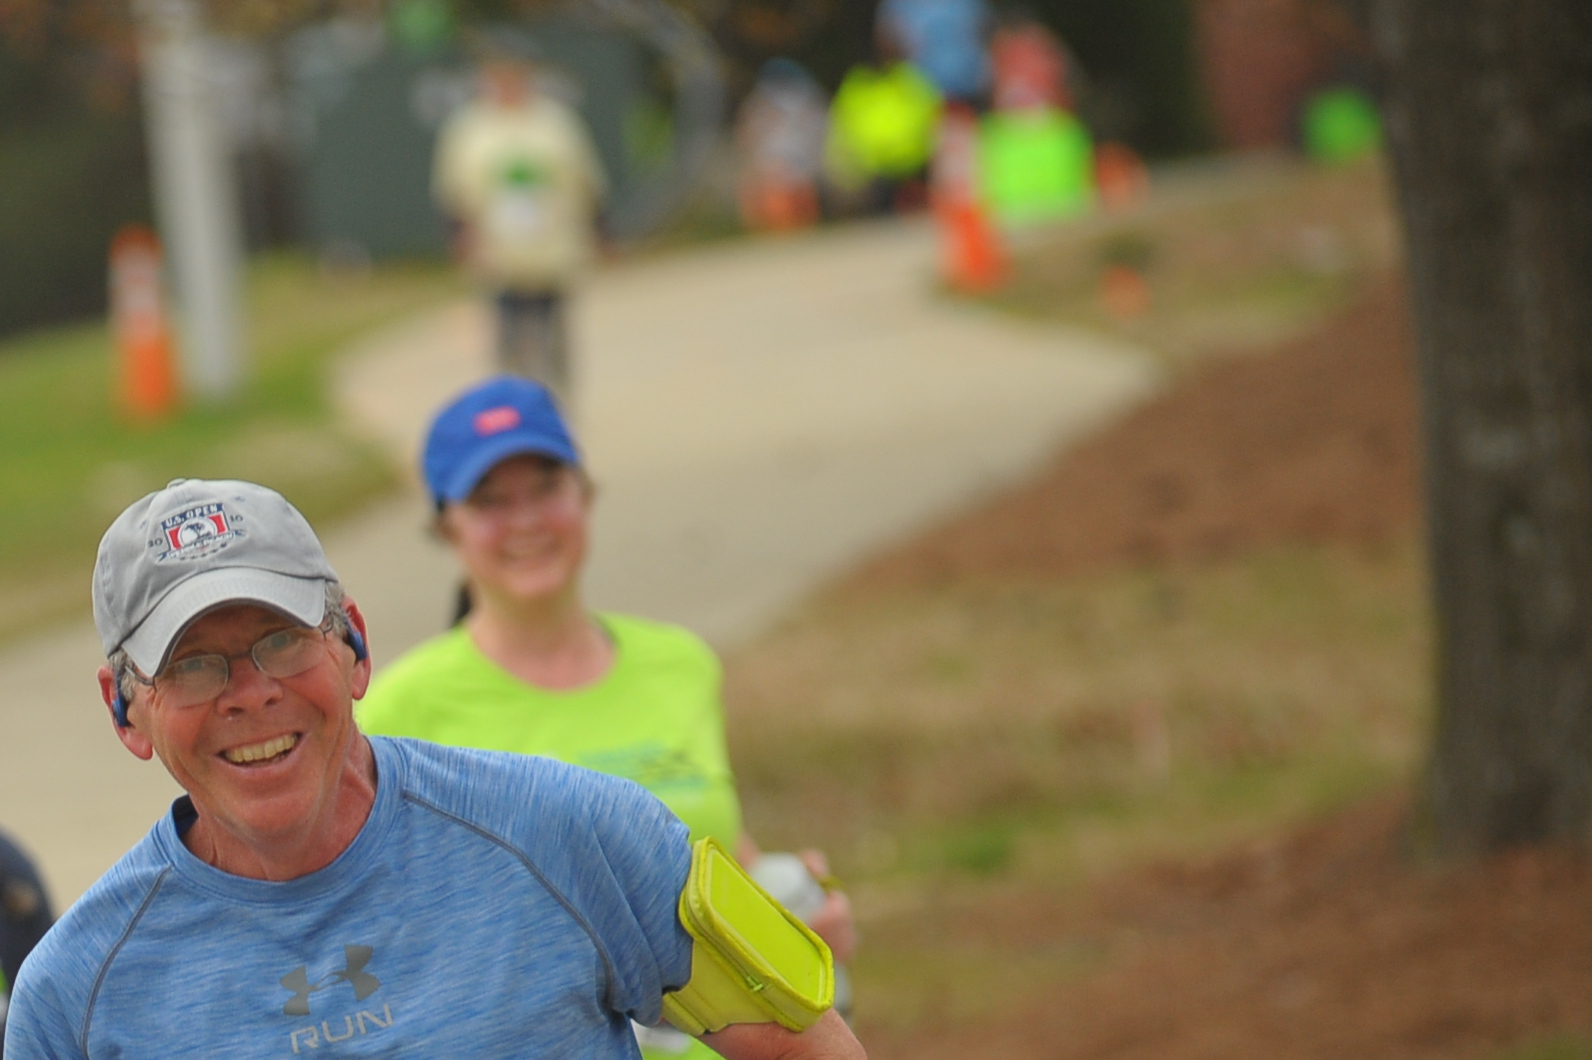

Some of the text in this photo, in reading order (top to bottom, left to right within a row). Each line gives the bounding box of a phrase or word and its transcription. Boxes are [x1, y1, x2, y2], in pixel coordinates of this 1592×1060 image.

[166, 504, 218, 527] U.S. OPEN
[290, 1003, 394, 1054] RUN
